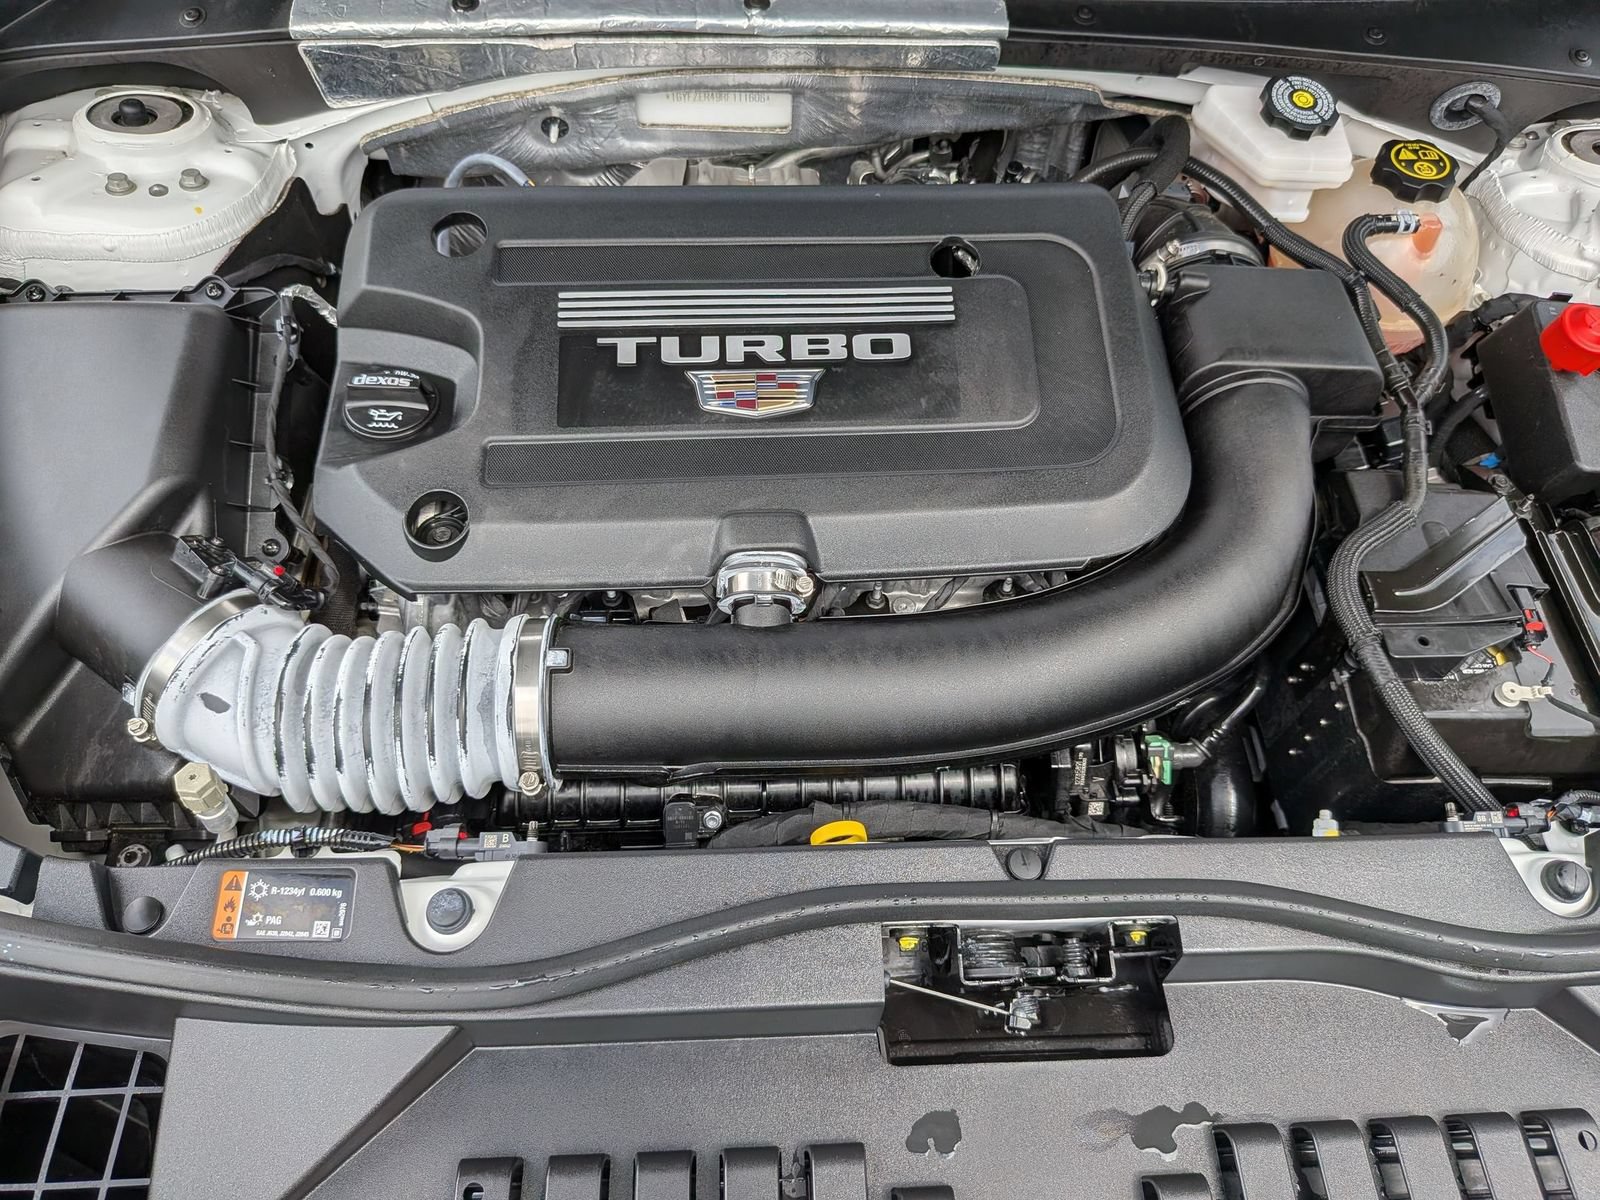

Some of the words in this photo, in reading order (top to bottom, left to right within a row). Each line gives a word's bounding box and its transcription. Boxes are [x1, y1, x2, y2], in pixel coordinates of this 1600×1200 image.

[597, 333, 912, 366] TURBO
[352, 374, 414, 387] dexos
[502, 833, 509, 843] B
[271, 887, 306, 897] R-1234yf
[309, 888, 331, 896] 0.600
[331, 888, 343, 898] kg
[265, 915, 282, 924] PAG
